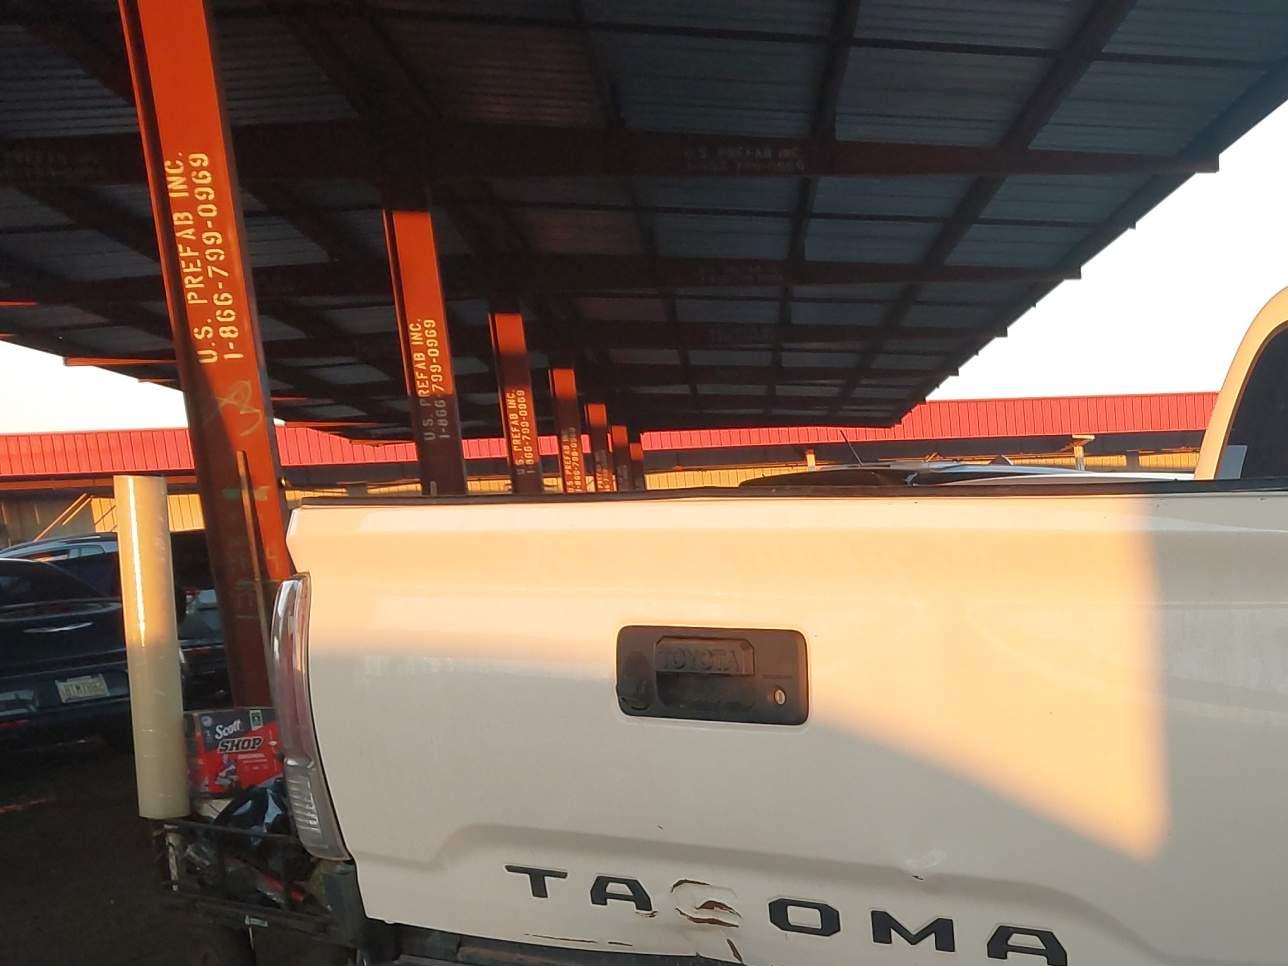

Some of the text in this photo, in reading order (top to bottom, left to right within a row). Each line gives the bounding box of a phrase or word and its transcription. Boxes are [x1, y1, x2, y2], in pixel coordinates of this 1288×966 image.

[165, 151, 218, 364] U.S. PREFAB INC.
[188, 152, 244, 360] 1-866-799-0969
[409, 319, 424, 345] INC.
[413, 352, 432, 407] PREFAB
[214, 719, 241, 740] Scott
[218, 737, 262, 753] SHOP
